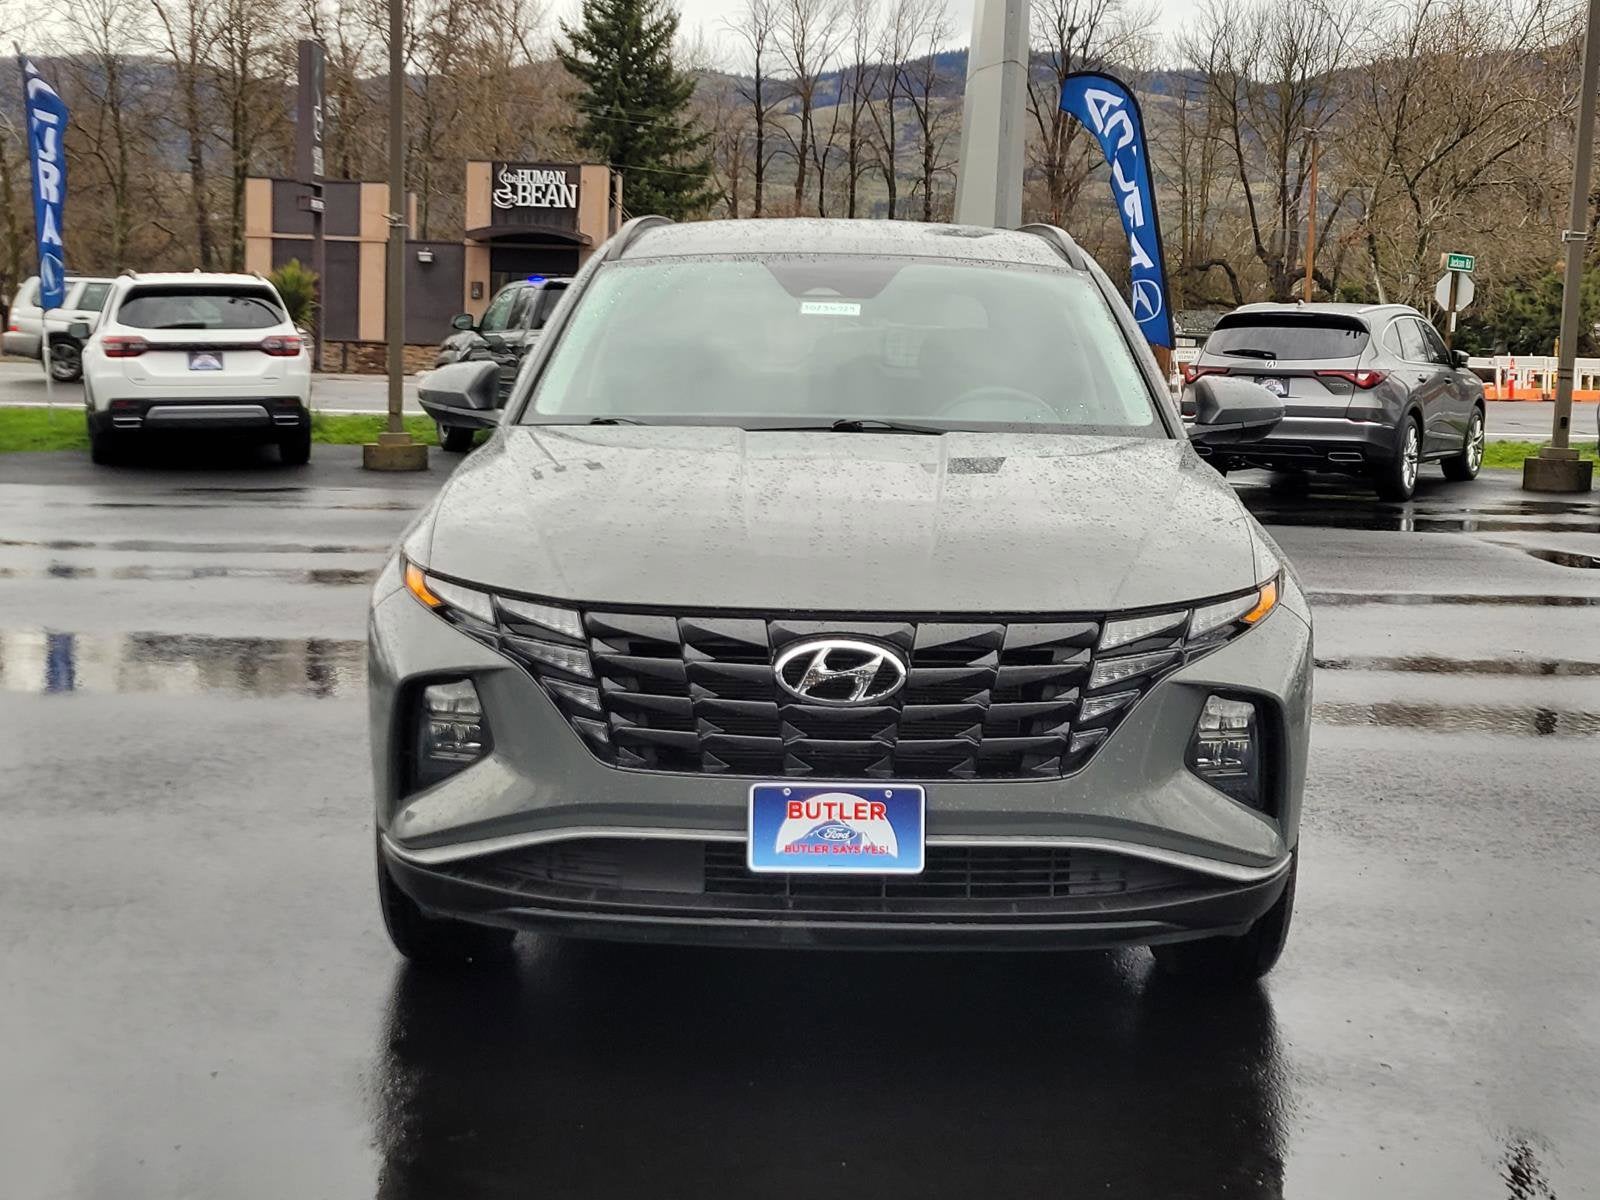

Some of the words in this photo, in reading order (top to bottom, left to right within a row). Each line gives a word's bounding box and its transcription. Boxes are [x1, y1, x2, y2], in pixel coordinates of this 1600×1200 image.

[516, 169, 567, 185] HUMAN
[516, 183, 578, 208] BEAN
[1449, 256, 1465, 268] Jackson
[787, 801, 886, 821] BUTLER
[823, 828, 850, 840] Ford
[784, 844, 829, 854] BUTLER
[833, 844, 860, 854] SAYS
[863, 845, 889, 854] YES!
